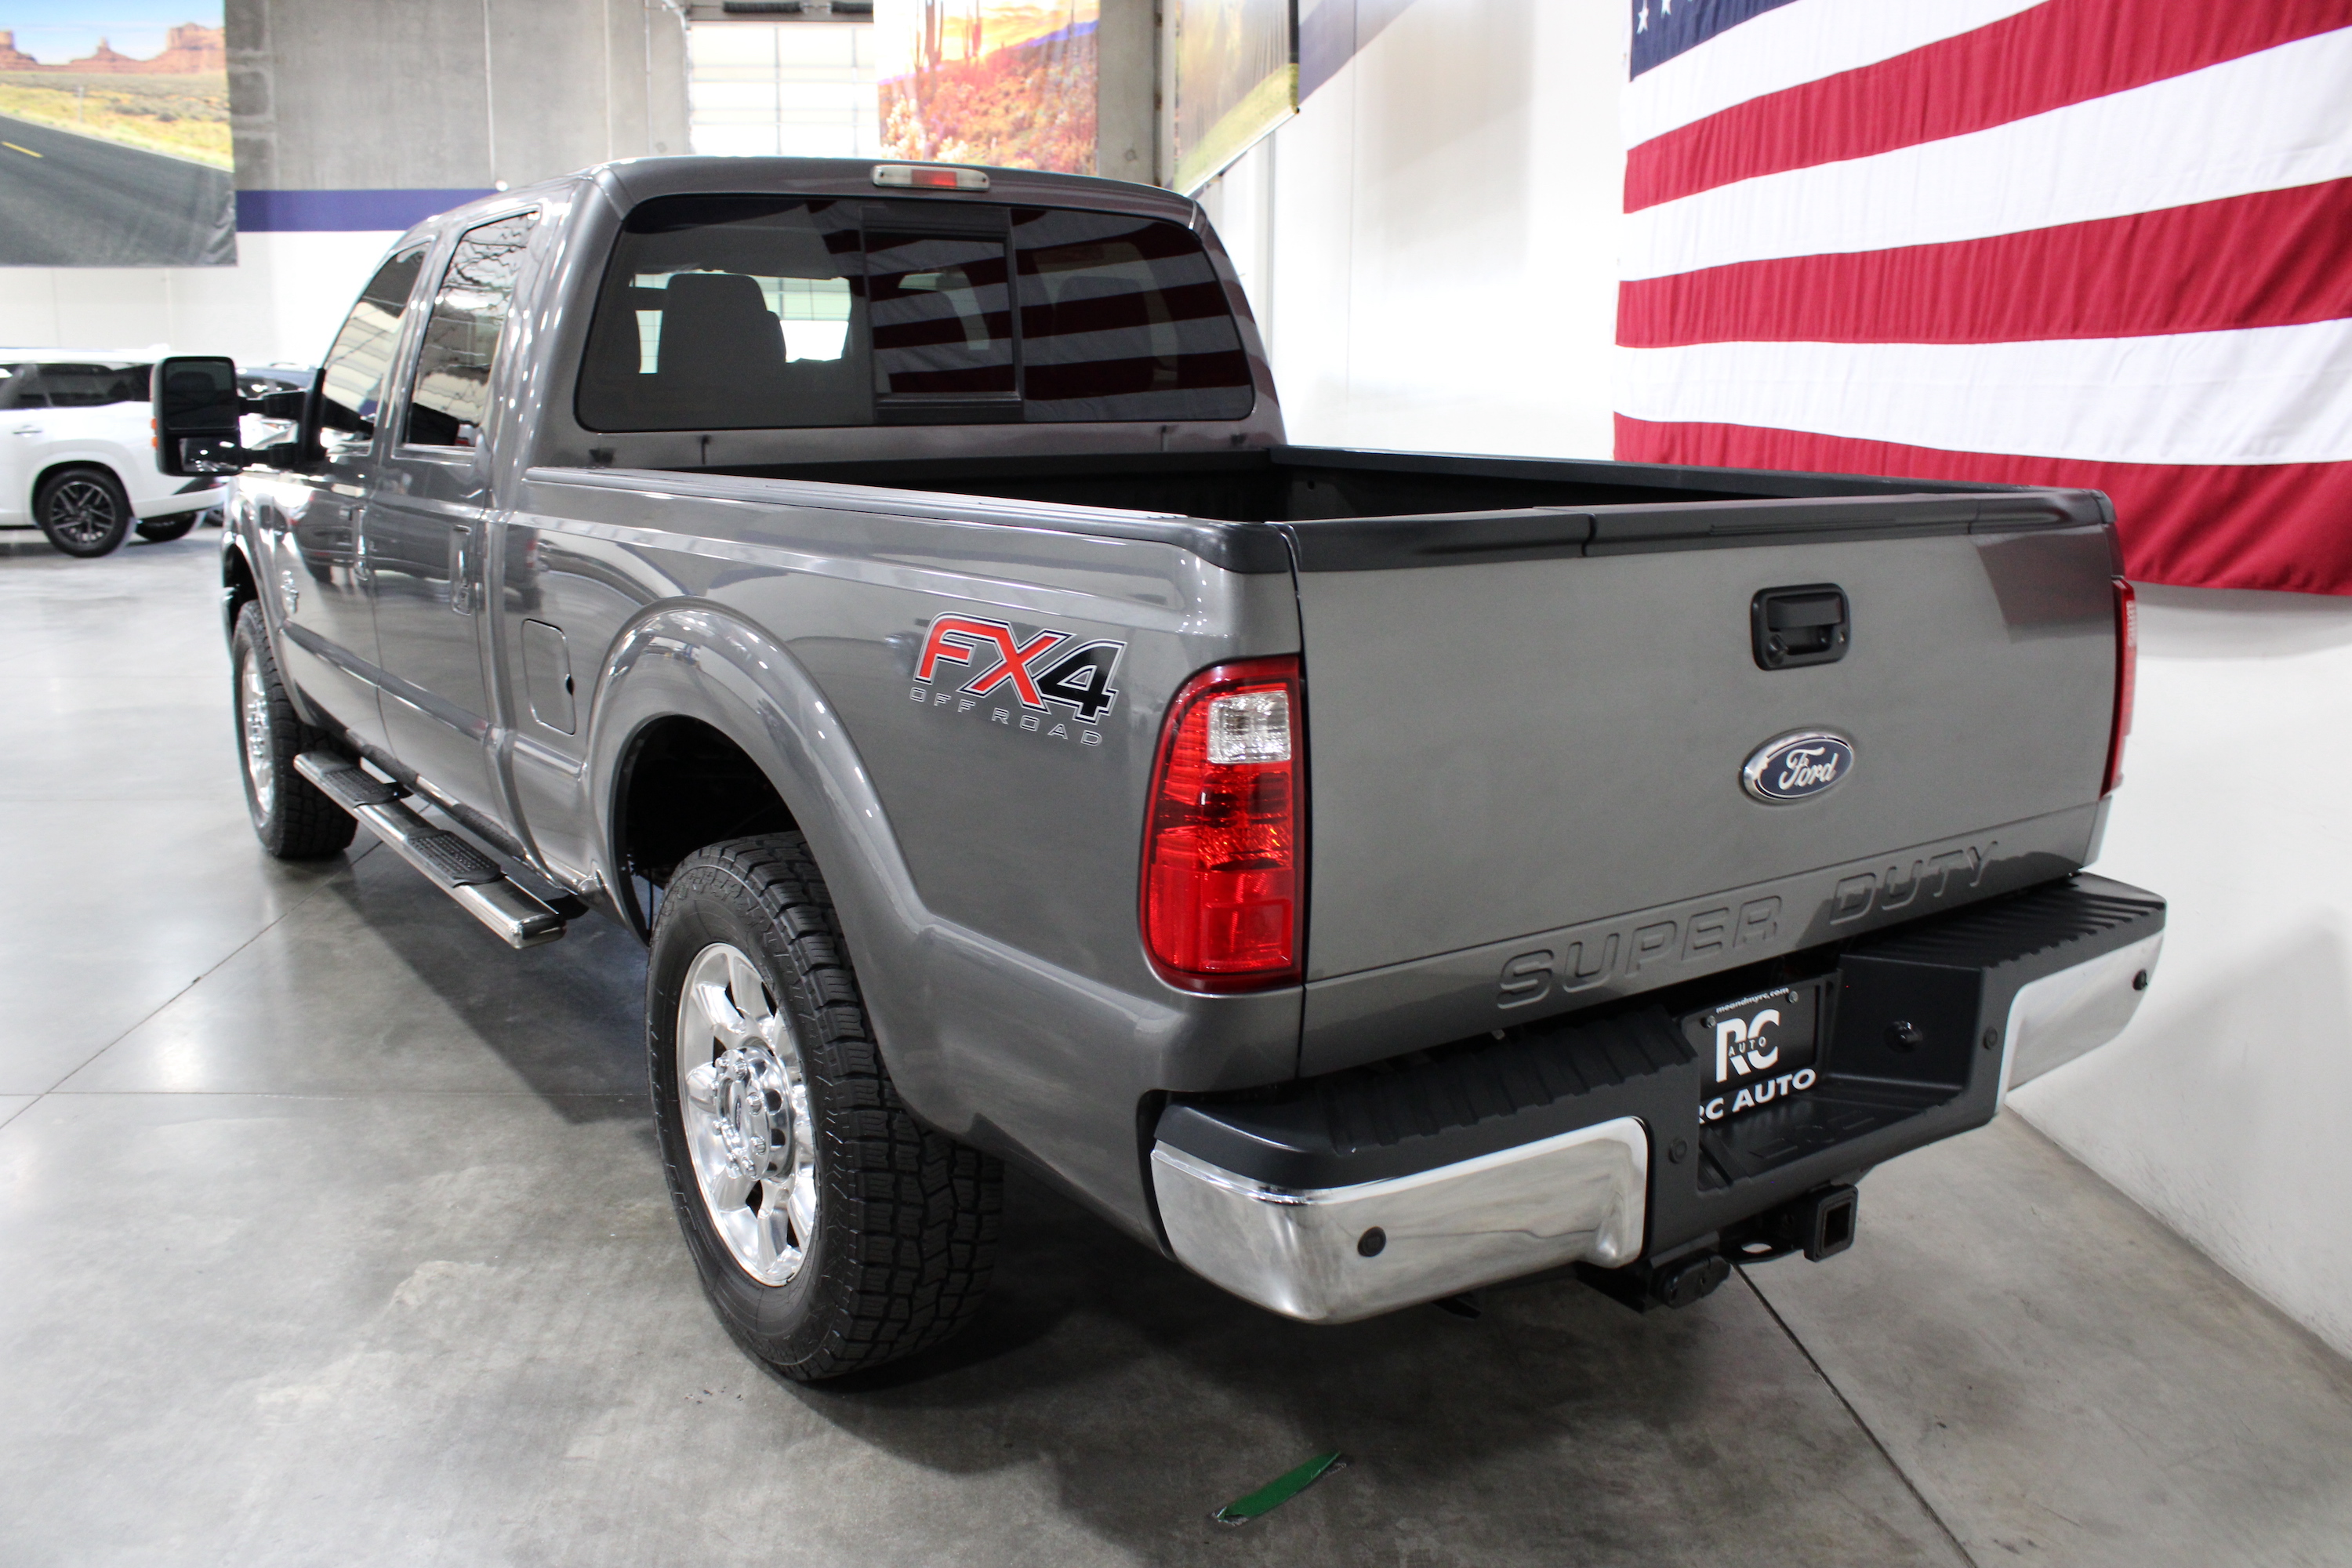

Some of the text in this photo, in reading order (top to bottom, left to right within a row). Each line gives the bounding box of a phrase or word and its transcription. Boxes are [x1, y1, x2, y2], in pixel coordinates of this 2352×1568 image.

[913, 611, 1127, 725] FX4
[909, 687, 1103, 746] OFF ROAD
[1778, 746, 1839, 790] Ford
[1497, 840, 1998, 1009] SUPER DUTY
[1715, 1008, 1780, 1083] RC
[1728, 1036, 1767, 1057] AUTO
[1732, 1068, 1817, 1112] AUTO
